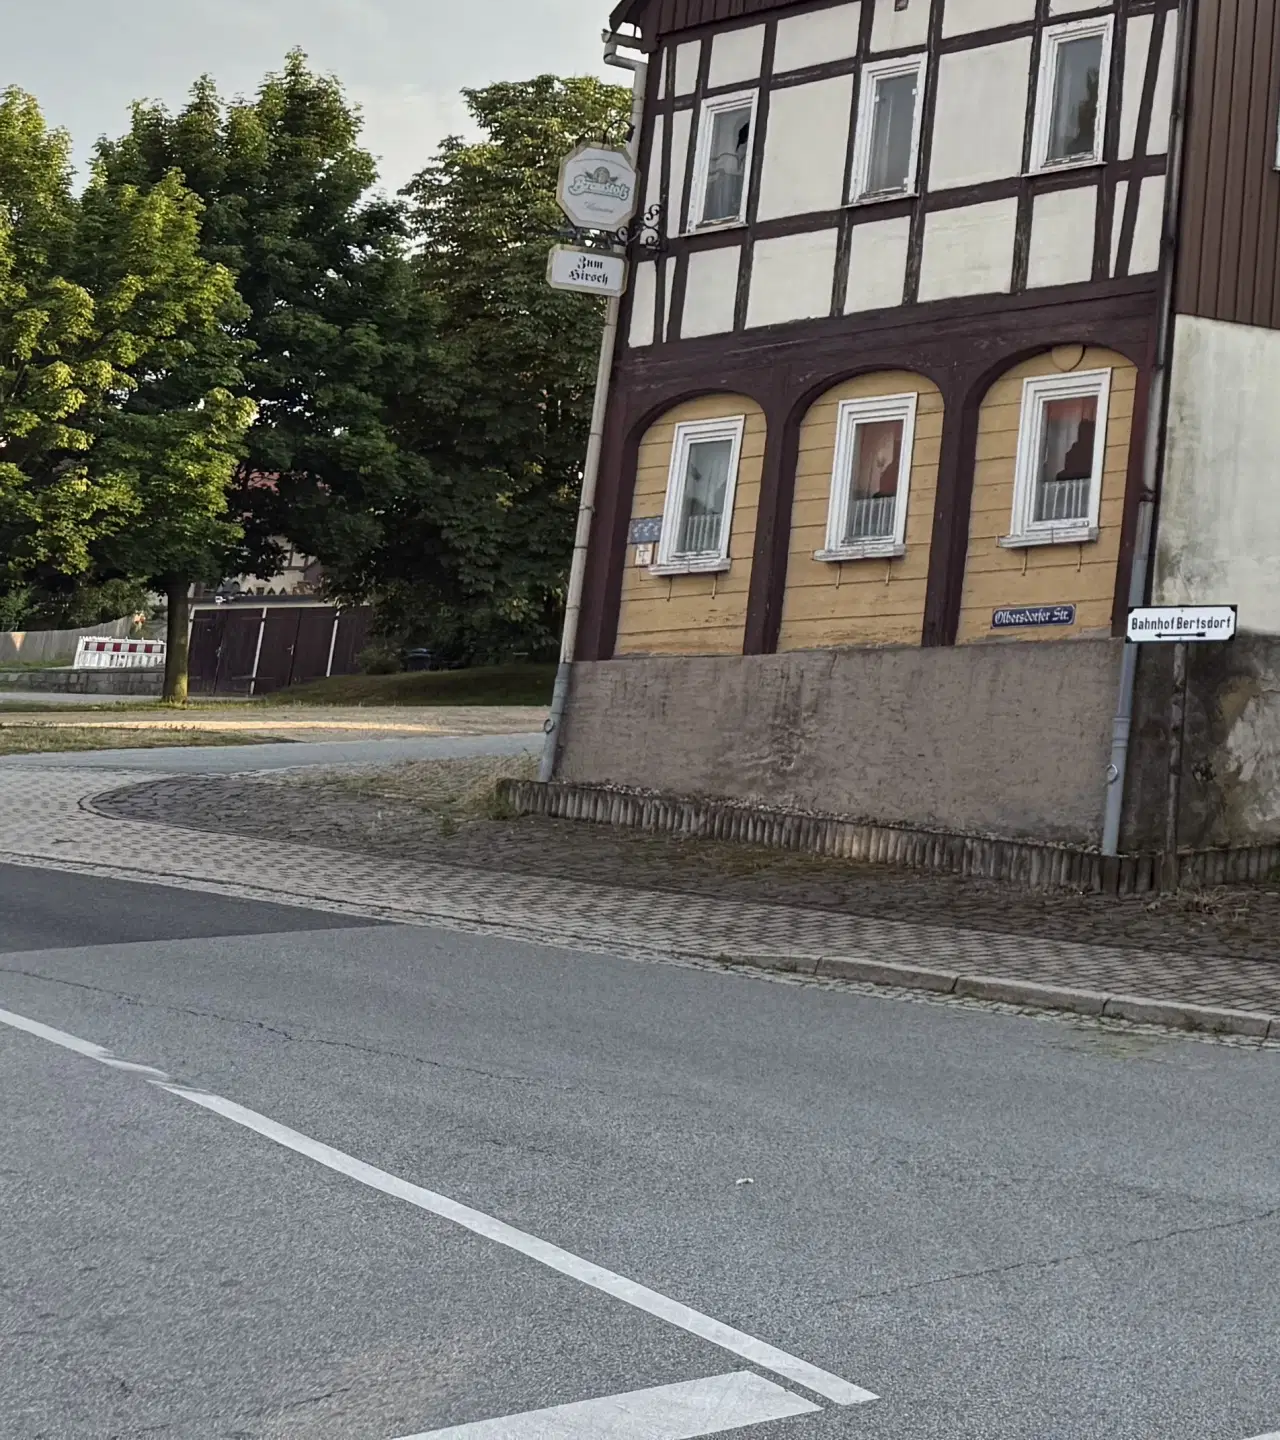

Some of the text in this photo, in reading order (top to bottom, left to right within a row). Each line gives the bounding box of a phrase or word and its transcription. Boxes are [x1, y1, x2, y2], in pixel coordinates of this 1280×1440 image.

[577, 256, 603, 269] Zum
[569, 269, 608, 285] Hirsch
[995, 608, 1069, 624] Olbersdorfer Str.
[1131, 616, 1231, 630] Bahnhof Bertsdorf
